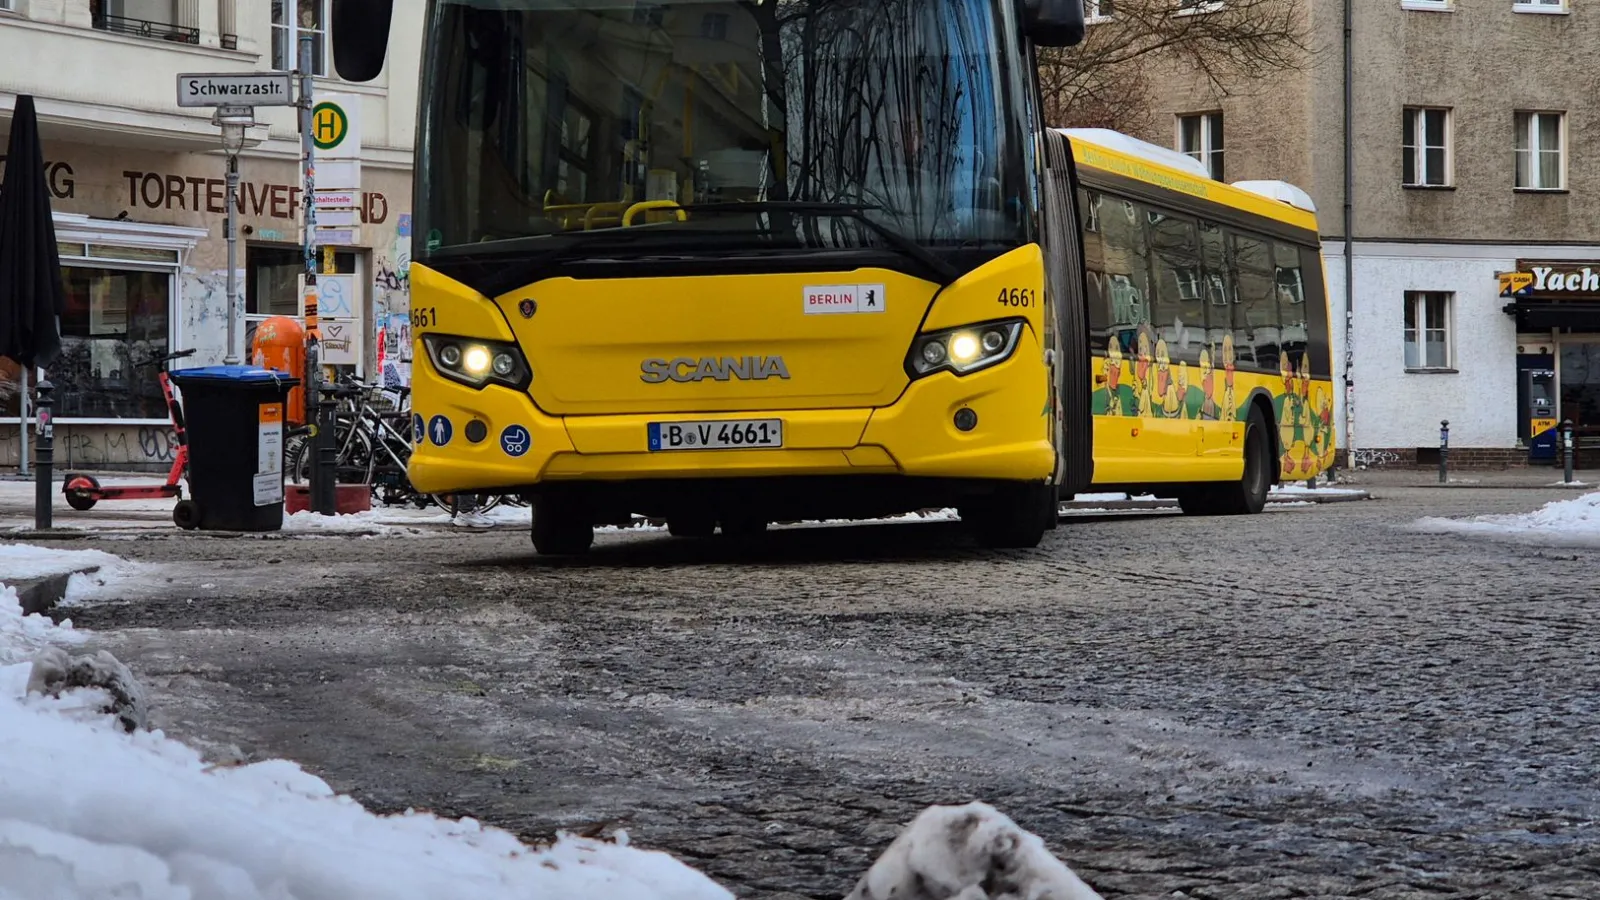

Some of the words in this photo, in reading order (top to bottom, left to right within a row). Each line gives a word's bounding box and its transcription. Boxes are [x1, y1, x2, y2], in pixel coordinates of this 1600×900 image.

[188, 79, 283, 96] Schwarzastr.
[317, 112, 335, 139] H
[122, 170, 388, 225] TORTENVERD
[1512, 276, 1530, 284] CASH
[809, 294, 852, 305] BERLIN
[998, 287, 1036, 308] 4661
[409, 307, 437, 328] 661
[640, 355, 791, 384] SCANIA
[669, 425, 683, 447] B
[697, 424, 711, 446] V
[717, 422, 772, 445] 4661
